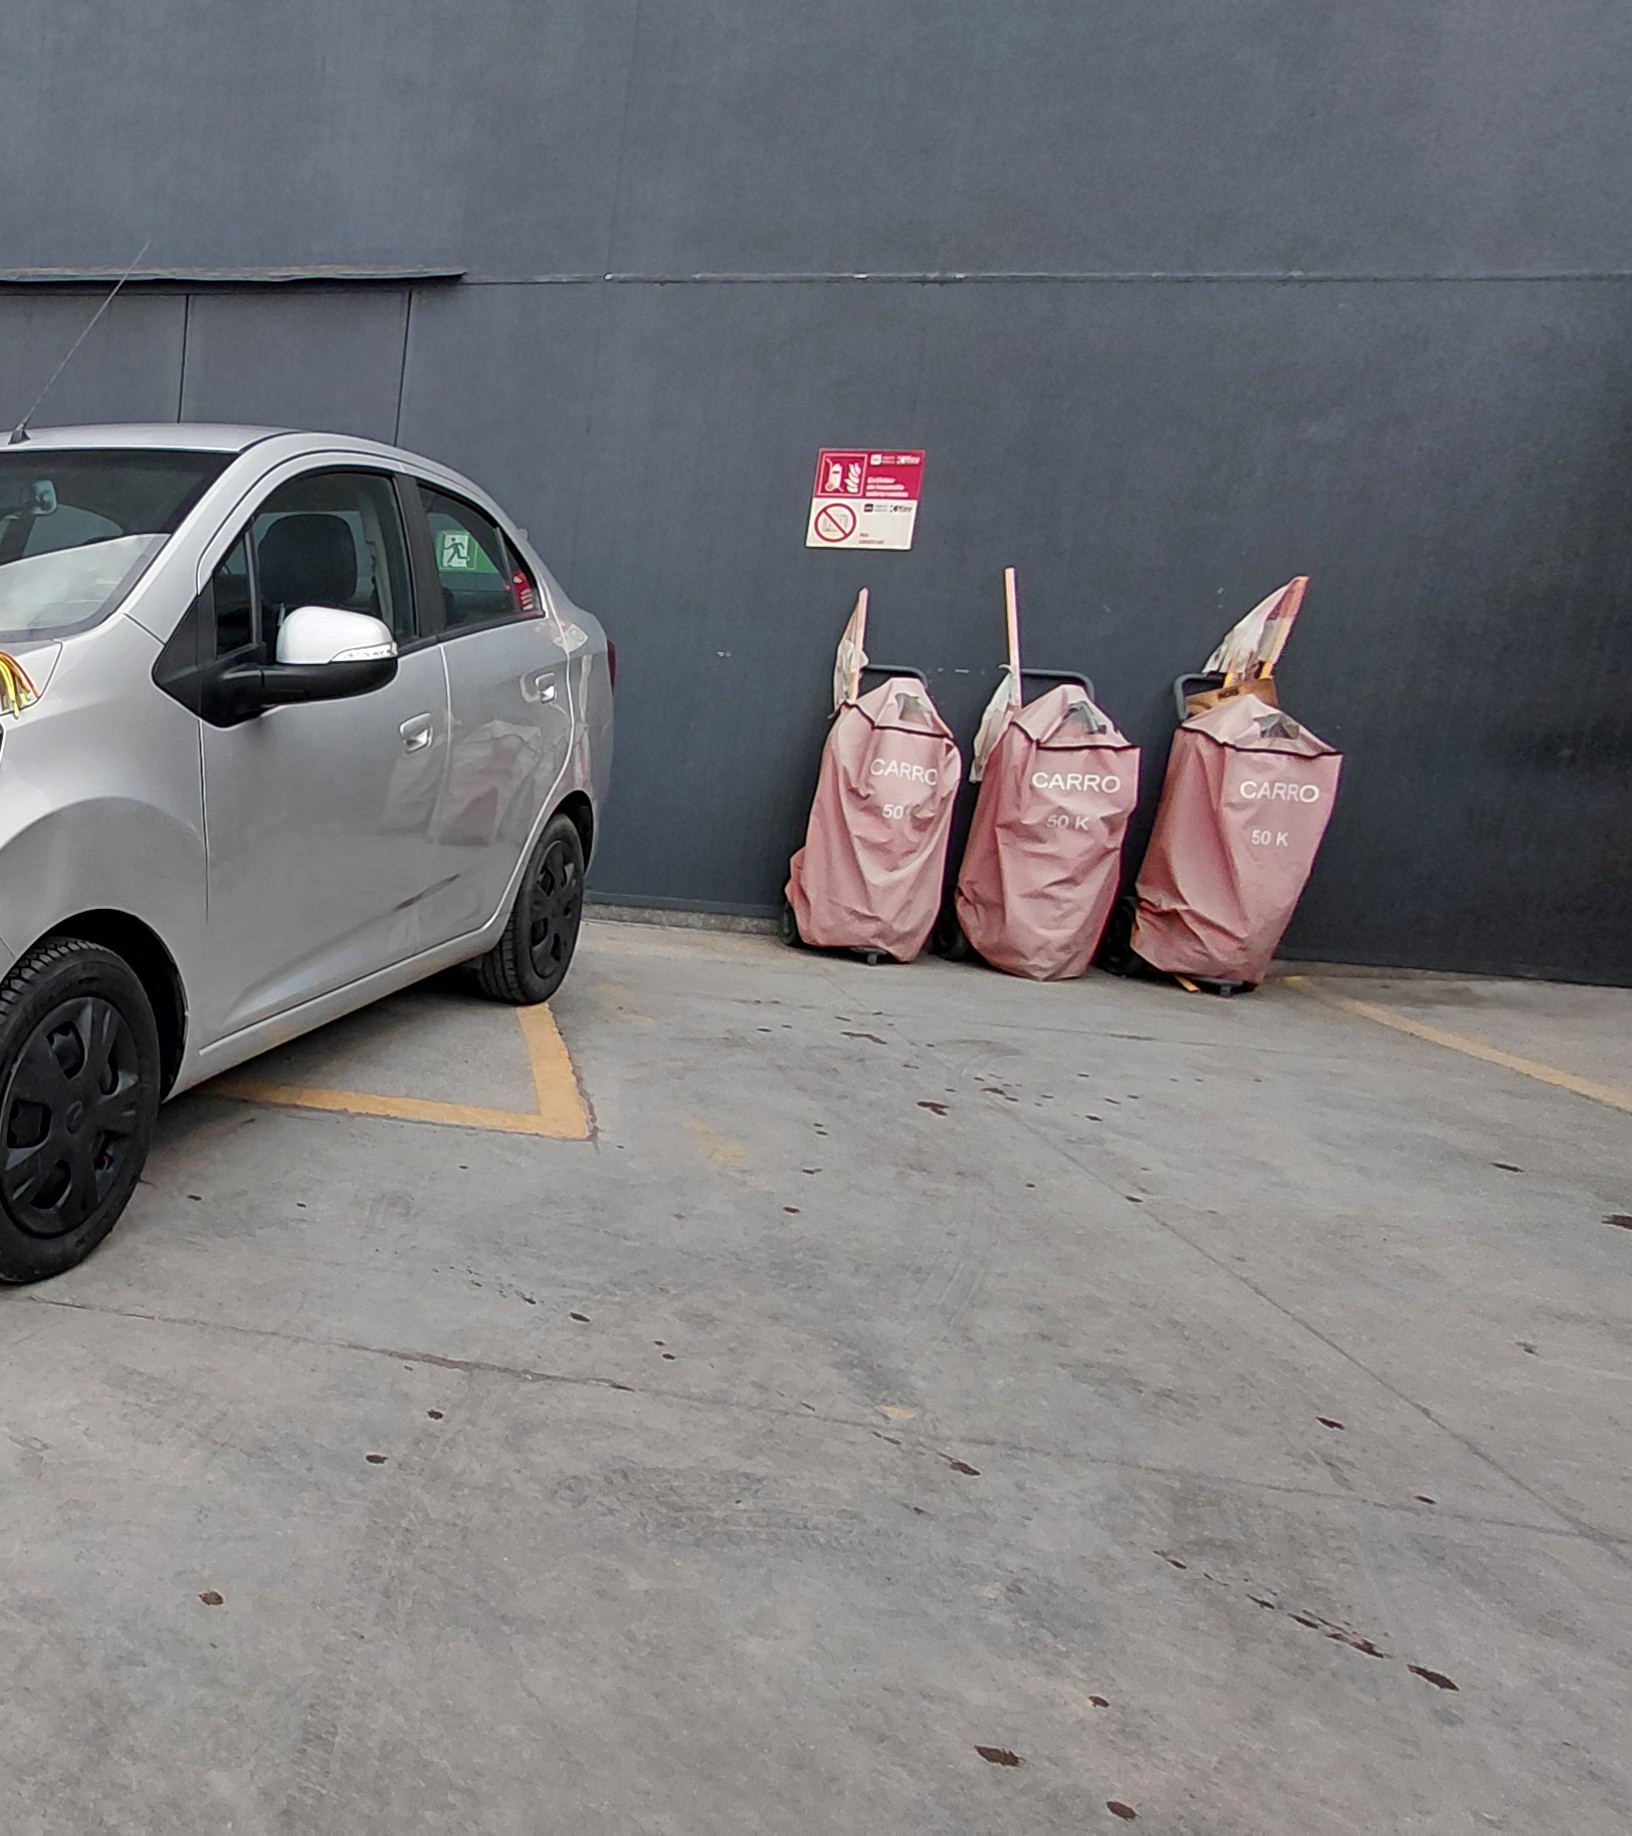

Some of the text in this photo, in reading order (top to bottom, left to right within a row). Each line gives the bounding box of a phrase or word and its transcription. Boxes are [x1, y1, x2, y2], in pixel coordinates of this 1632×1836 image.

[1031, 771, 1121, 794] CARRO
[1239, 780, 1320, 803] CARRO
[882, 803, 904, 820] 50
[1046, 814, 1090, 831] 50 K
[1251, 829, 1289, 847] 50 K
